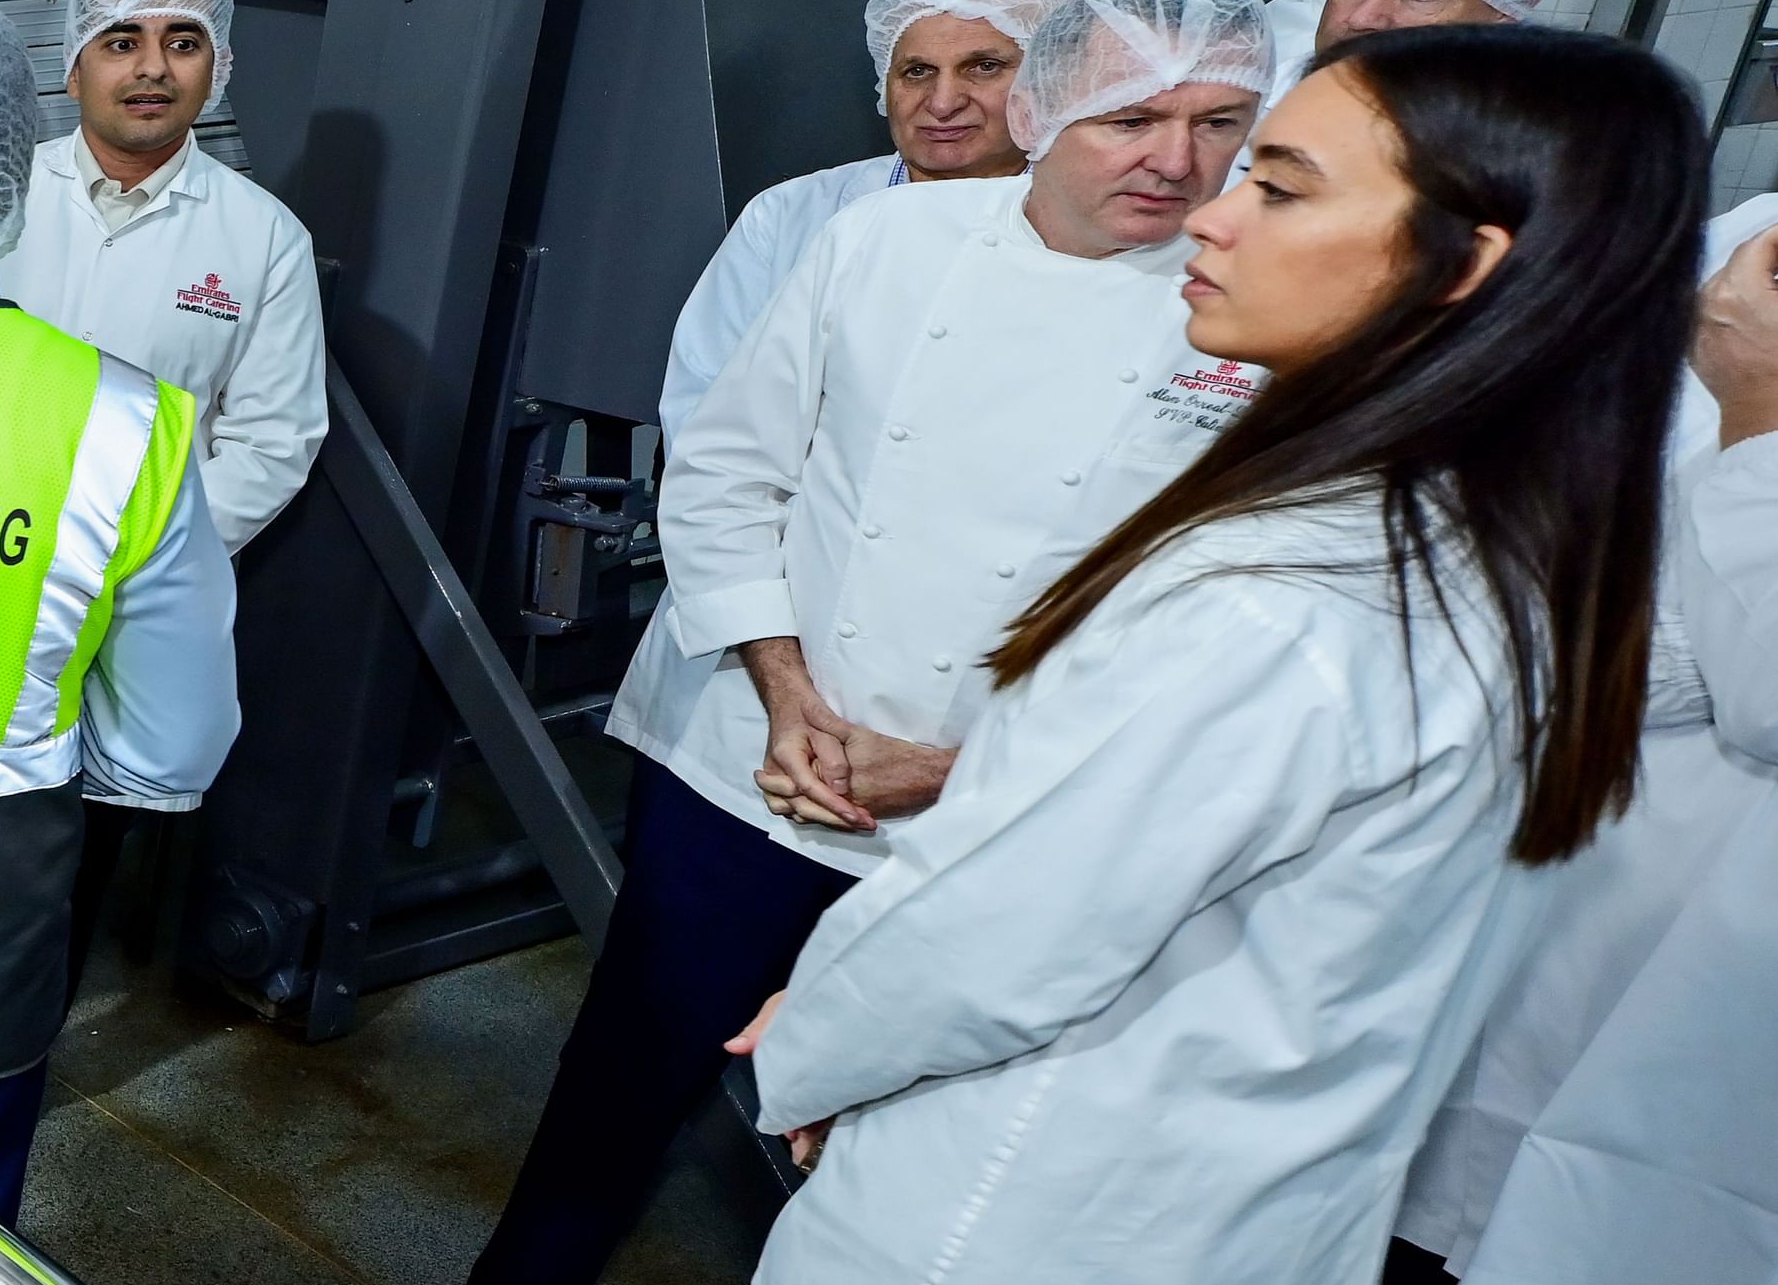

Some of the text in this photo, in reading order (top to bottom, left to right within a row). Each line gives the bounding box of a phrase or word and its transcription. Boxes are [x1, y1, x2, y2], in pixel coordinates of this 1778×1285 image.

[192, 284, 230, 300] Emirates
[176, 302, 240, 322] AHMED AL-GABRI
[177, 291, 240, 314] Flight Catering
[1170, 376, 1256, 401] Flight Caterin
[1195, 370, 1252, 388] Emirates
